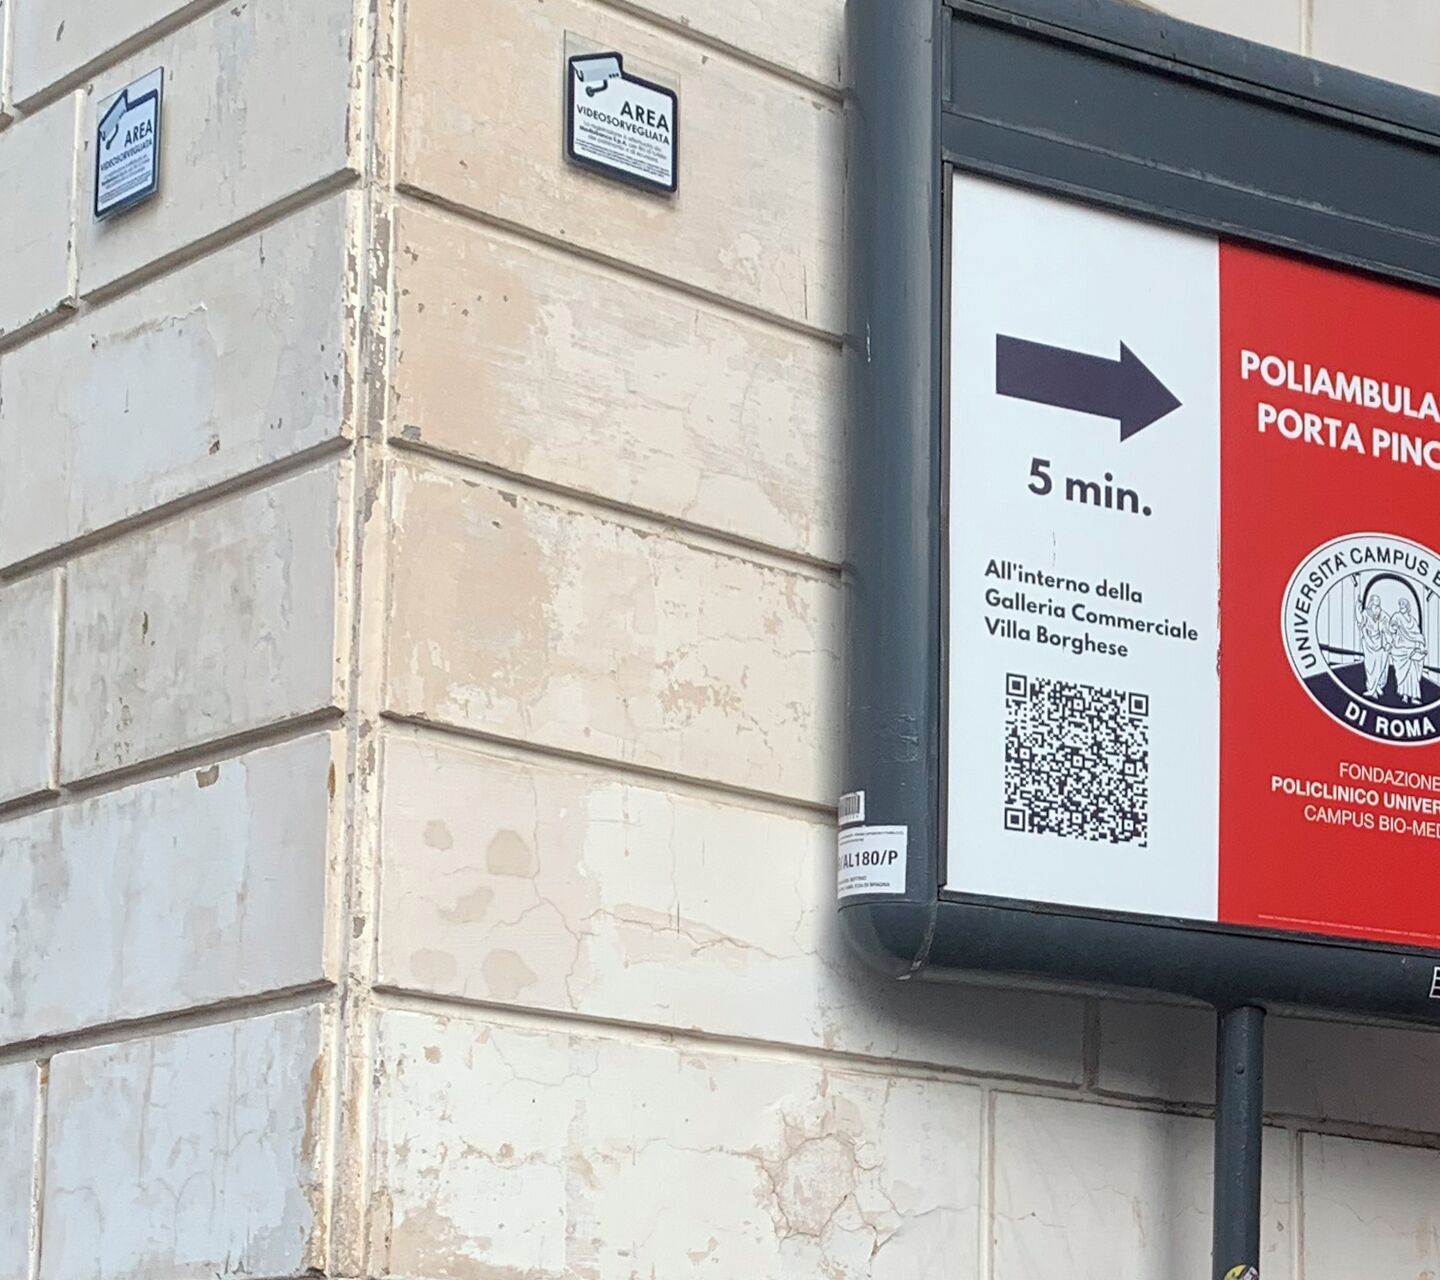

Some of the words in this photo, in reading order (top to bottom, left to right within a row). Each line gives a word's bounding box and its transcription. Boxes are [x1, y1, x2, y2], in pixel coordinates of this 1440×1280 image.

[124, 119, 154, 148] AREA
[576, 103, 671, 146] VIDEOSORVEGLIATA
[620, 100, 670, 133] AREA
[1257, 401, 1366, 456] PORTA
[1027, 456, 1053, 496] 5
[1065, 471, 1153, 517] min.
[984, 558, 1091, 595] All'interno
[1095, 578, 1144, 604] della
[1349, 546, 1430, 578] CAMPUS
[985, 587, 1066, 619] Galleria
[1071, 602, 1199, 642] Commerciale
[984, 615, 1031, 642] Villa
[1036, 624, 1129, 658] Borghese
[1344, 700, 1368, 727] DI
[1375, 716, 1437, 738] ROMA
[1271, 775, 1380, 807] POLICLINICO
[1303, 804, 1375, 830] CAMPUS
[841, 849, 899, 871] AL180/P
